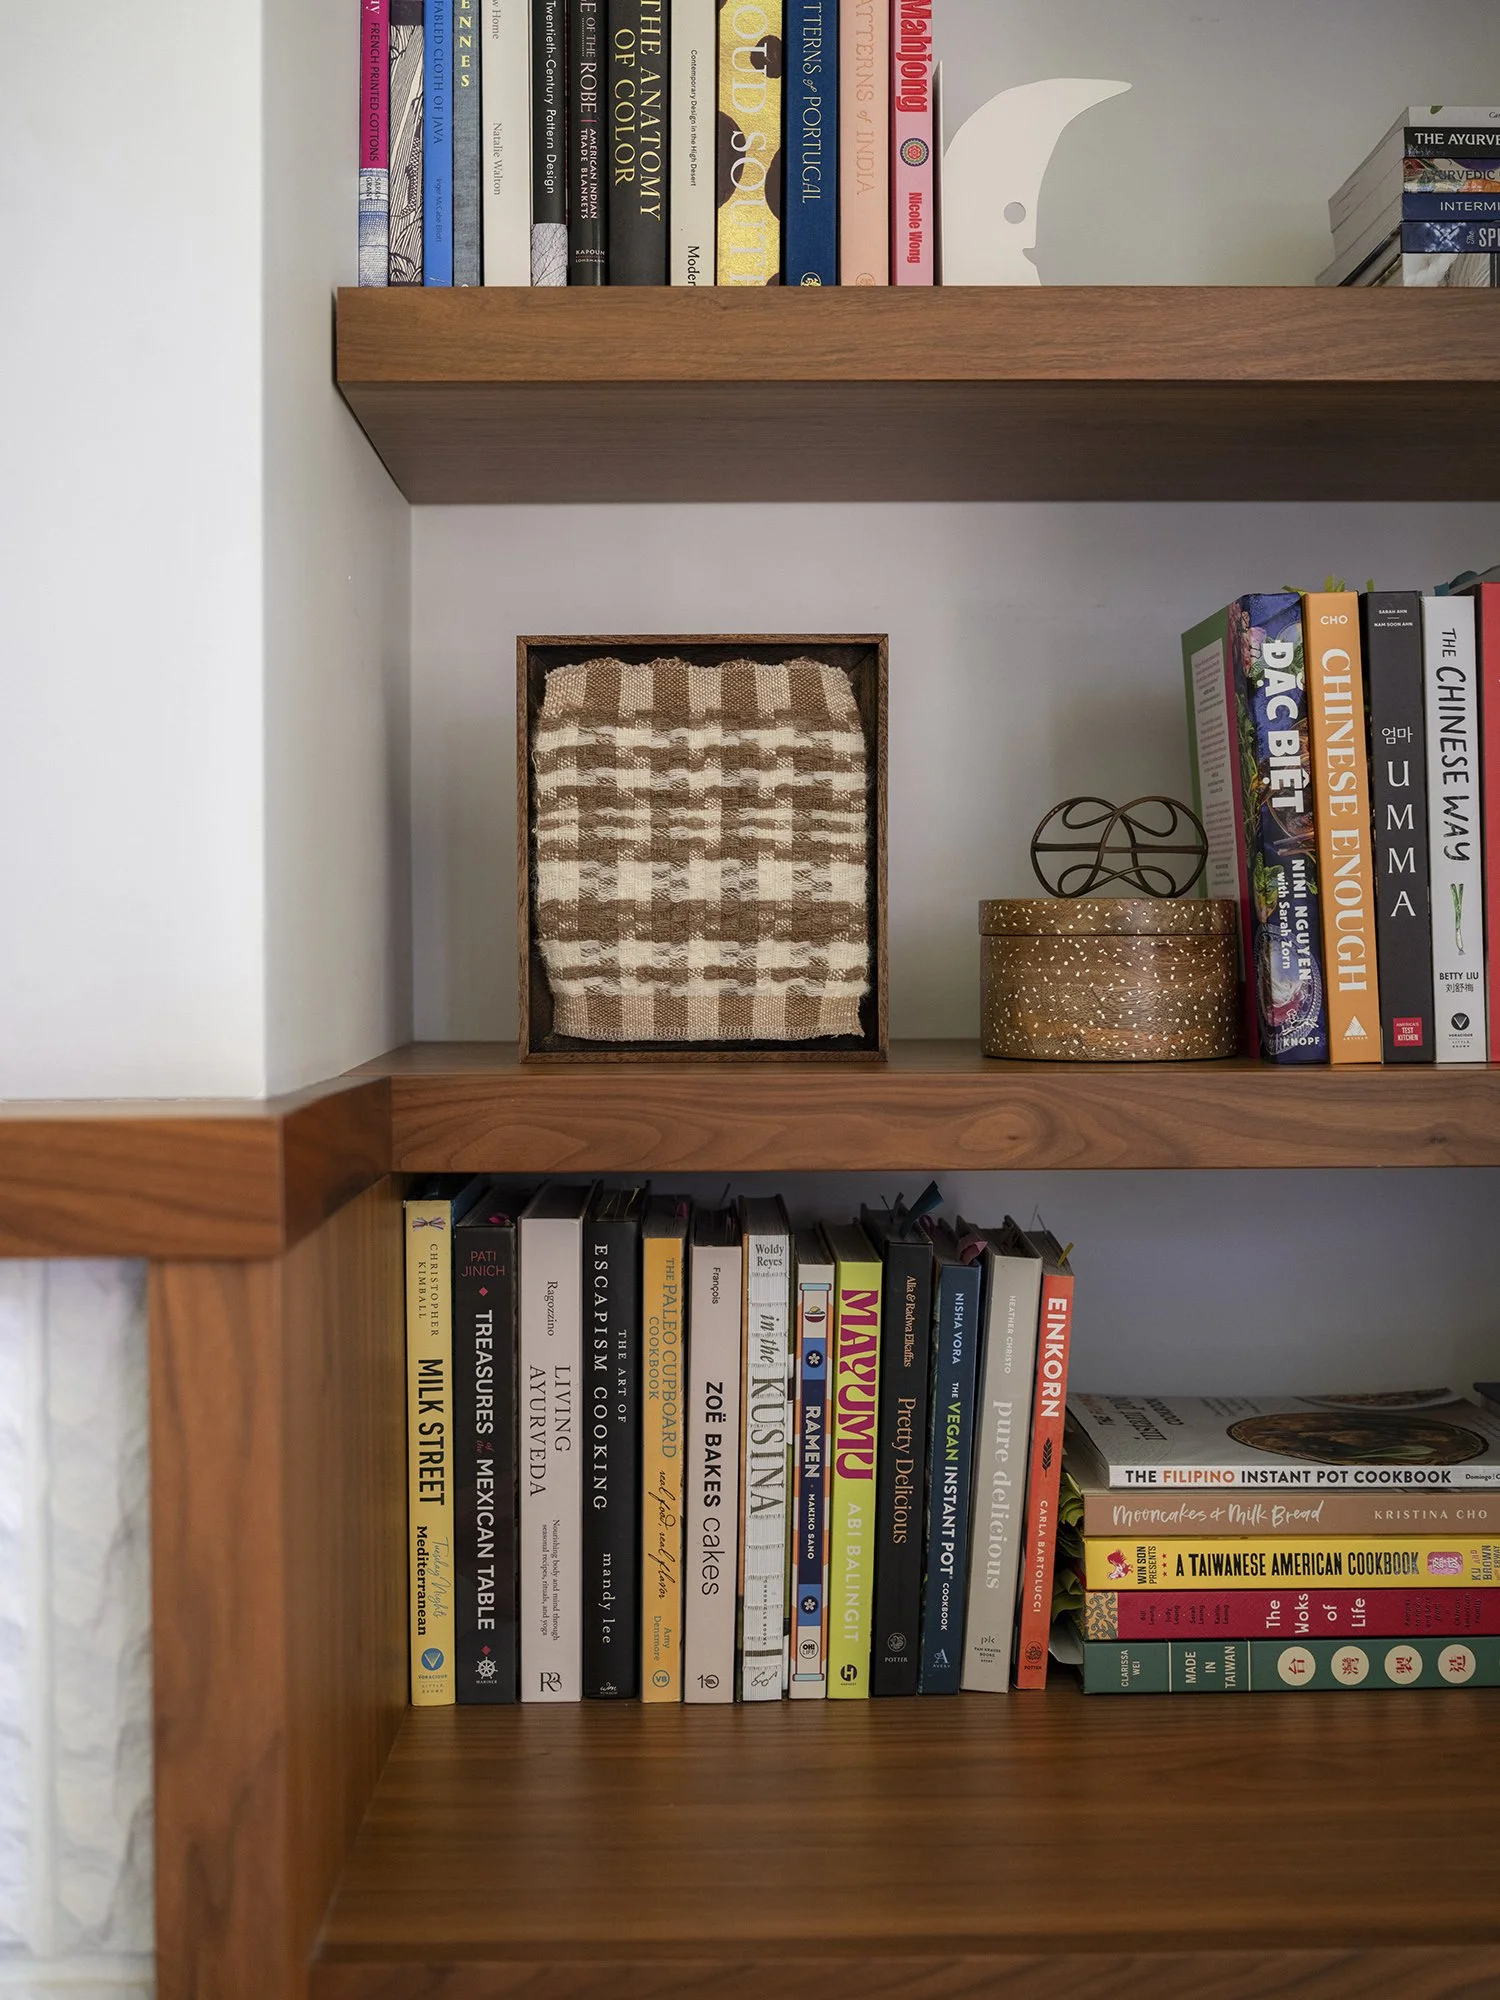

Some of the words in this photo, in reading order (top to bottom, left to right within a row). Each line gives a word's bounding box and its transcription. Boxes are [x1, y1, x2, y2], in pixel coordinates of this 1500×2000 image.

[370, 23, 380, 63] FRENCH
[434, 1, 444, 45] FABLED
[492, 10, 501, 40] Home
[586, 17, 596, 33] OF
[640, 0, 662, 56] THE
[544, 2, 557, 105] Twentieth-Century
[586, 34, 596, 58] THE
[614, 28, 635, 68] OF
[896, 0, 933, 113] Mahjong
[370, 66, 380, 111] PRINTED
[434, 48, 444, 91] CLOTH
[580, 62, 597, 113] ROBE
[689, 49, 698, 99] Contemporary
[803, 79, 818, 93] of
[434, 95, 444, 112] OF
[689, 101, 698, 124] Design
[856, 110, 873, 124] of
[370, 113, 380, 161] COTTONS
[432, 117, 444, 144] JAVA
[493, 123, 502, 157] Natalie
[546, 109, 557, 150] Pattern
[580, 129, 588, 162] TRADE
[614, 78, 635, 186] COLOR
[640, 67, 662, 221] ANATOMY
[1414, 132, 1445, 145] THE
[589, 128, 598, 174] AMERICAN
[689, 145, 697, 163] High
[802, 96, 822, 204] PORTUGAL
[856, 129, 875, 196] INDIA
[493, 157, 502, 196] Walton
[544, 154, 557, 195] Design
[580, 167, 588, 220] BLANKETS
[1421, 169, 1496, 181] AYURVEDIC
[590, 175, 598, 220] INDIAN
[908, 192, 922, 229] Nicole
[906, 232, 922, 264] Wong
[1319, 614, 1348, 625] CHO
[1441, 628, 1457, 657] THE
[1321, 648, 1360, 817] CHINESE
[1381, 725, 1414, 745] 엄마
[1435, 666, 1470, 786] CHINESE
[1261, 730, 1311, 814] BIỆT
[1442, 795, 1471, 863] WAY
[1276, 872, 1286, 898] with
[1291, 860, 1307, 898] NINI
[1278, 901, 1291, 938] Sarah
[1330, 829, 1368, 992] ENOUGH
[1280, 940, 1292, 970] Zorn
[1294, 905, 1313, 981] NGUYEN
[1439, 972, 1464, 980] BETTY
[1465, 972, 1480, 980] LIU
[1283, 1036, 1320, 1046] KNOPF
[470, 1251, 497, 1262] PATI
[666, 1257, 675, 1281] THE
[755, 1243, 785, 1258] Woldy
[757, 1255, 783, 1269] Reyes
[418, 1261, 427, 1319] KIMBALL
[430, 1243, 439, 1336] CHRISTOPHER
[461, 1266, 505, 1277] JINICH
[709, 1267, 721, 1305] François
[544, 1280, 559, 1337] Ragozzino
[594, 1244, 608, 1372] ESCAPISM
[662, 1284, 678, 1346] PALEO
[904, 1303, 916, 1332] Radwa
[905, 1293, 916, 1303] &
[953, 1292, 965, 1327] NISHA
[1007, 1295, 1017, 1335] HEATHER
[760, 1314, 780, 1332] in
[617, 1329, 627, 1360] THE
[648, 1316, 660, 1400] COOKBOOK
[760, 1336, 781, 1364] the
[903, 1334, 915, 1367] Elkaffas
[951, 1328, 964, 1365] VORA
[1004, 1336, 1014, 1374] CHRISTO
[1040, 1297, 1068, 1418] EINKORN
[418, 1359, 444, 1415] MILK
[475, 1309, 494, 1435] TREASURES
[617, 1368, 627, 1396] ART
[836, 1289, 879, 1481] MAYUMU
[951, 1382, 960, 1399] THE
[554, 1365, 572, 1452] LIVING
[617, 1404, 627, 1423] OF
[661, 1350, 678, 1459] CUPBOARD
[704, 1382, 727, 1424] ZOË
[529, 1365, 547, 1497] AYURVEDA
[750, 1376, 786, 1516] KUSINA
[804, 1406, 822, 1478] RAMEN
[892, 1397, 917, 1455] Pretty
[945, 1401, 961, 1461] VEGAN
[992, 1400, 1013, 1463] pure
[418, 1422, 445, 1506] STREET
[593, 1387, 608, 1510] COOKING
[703, 1433, 722, 1508] BAKES
[1125, 1470, 1157, 1483] THE
[1163, 1470, 1235, 1483] FILIPINO
[1241, 1470, 1311, 1484] INSTANT
[1316, 1470, 1349, 1484] POT
[1353, 1470, 1452, 1484] COOKBOOK
[1465, 1473, 1492, 1482] Domingo
[476, 1458, 495, 1559] MEXICAN
[808, 1494, 816, 1531] MAKIKO
[847, 1503, 862, 1537] ABI
[893, 1458, 915, 1545] Delicious
[941, 1466, 958, 1538] INSTANT
[1038, 1501, 1049, 1538] CARLA
[1112, 1502, 1207, 1527] Mooncakes
[1228, 1503, 1267, 1528] Milk
[1271, 1499, 1325, 1529] Bread
[1374, 1509, 1448, 1520] KRISTINA
[1456, 1509, 1488, 1519] CHO
[807, 1533, 815, 1560] SANO
[985, 1470, 1013, 1590] delicious
[702, 1517, 726, 1597] cakes
[1136, 1546, 1147, 1564] SON
[1137, 1565, 1147, 1585] WIN
[1148, 1545, 1157, 1585] PRESENTS
[1175, 1553, 1185, 1577] A
[1188, 1552, 1266, 1577] TAIWANESE
[1271, 1552, 1342, 1576] AMERICAN
[1347, 1551, 1420, 1576] COOKBOOK
[1481, 1544, 1493, 1581] BROWN
[416, 1525, 430, 1636] Mediterranean
[598, 1552, 616, 1612] mandy
[843, 1545, 862, 1642] BALINGIT
[1032, 1541, 1045, 1613] BARTOLUCCI
[477, 1564, 495, 1631] TABLE
[940, 1582, 949, 1631] COOKBOOK
[1266, 1599, 1281, 1629] The
[1294, 1593, 1309, 1634] Woks
[1322, 1604, 1338, 1622] of
[1351, 1597, 1366, 1628] Life
[602, 1619, 616, 1644] lee
[653, 1615, 662, 1662] Densmore
[662, 1627, 672, 1648] Amy
[1120, 1650, 1129, 1687] CLARISSA
[1132, 1660, 1141, 1676] WEI
[1185, 1651, 1197, 1684] MADE
[1205, 1661, 1216, 1673] IN
[1225, 1645, 1236, 1689] TAIWAN
